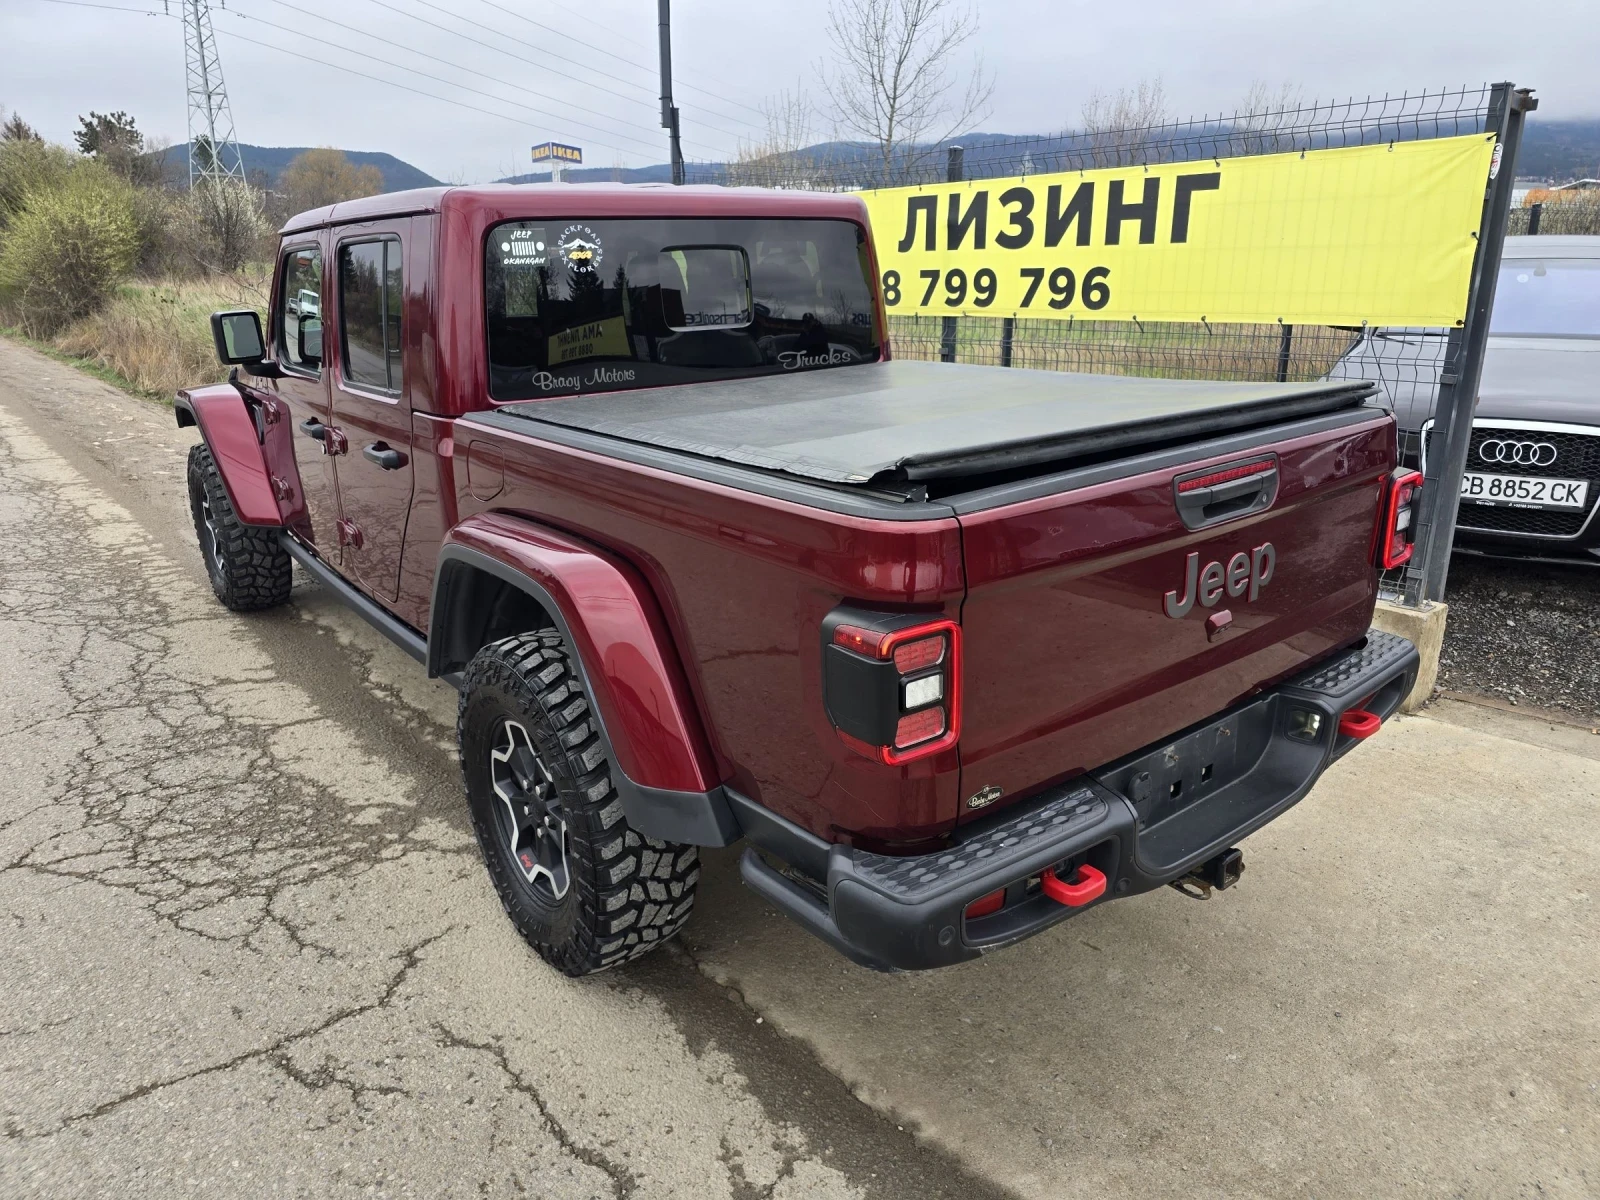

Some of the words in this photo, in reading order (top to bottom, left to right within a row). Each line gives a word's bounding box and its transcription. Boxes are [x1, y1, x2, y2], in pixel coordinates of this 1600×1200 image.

[532, 146, 550, 159] IKEA
[552, 146, 581, 161] IKEA
[898, 172, 1221, 253] ЛИЗИНГ
[510, 230, 532, 240] JEEP
[503, 257, 546, 265] OKANAGAN
[919, 268, 998, 308] 799
[1019, 266, 1111, 310] 796
[777, 348, 851, 370] Trucks
[584, 367, 636, 386] Motors
[1488, 478, 1546, 501] 8852
[1550, 482, 1582, 504] CK
[1163, 542, 1276, 619] Jeep
